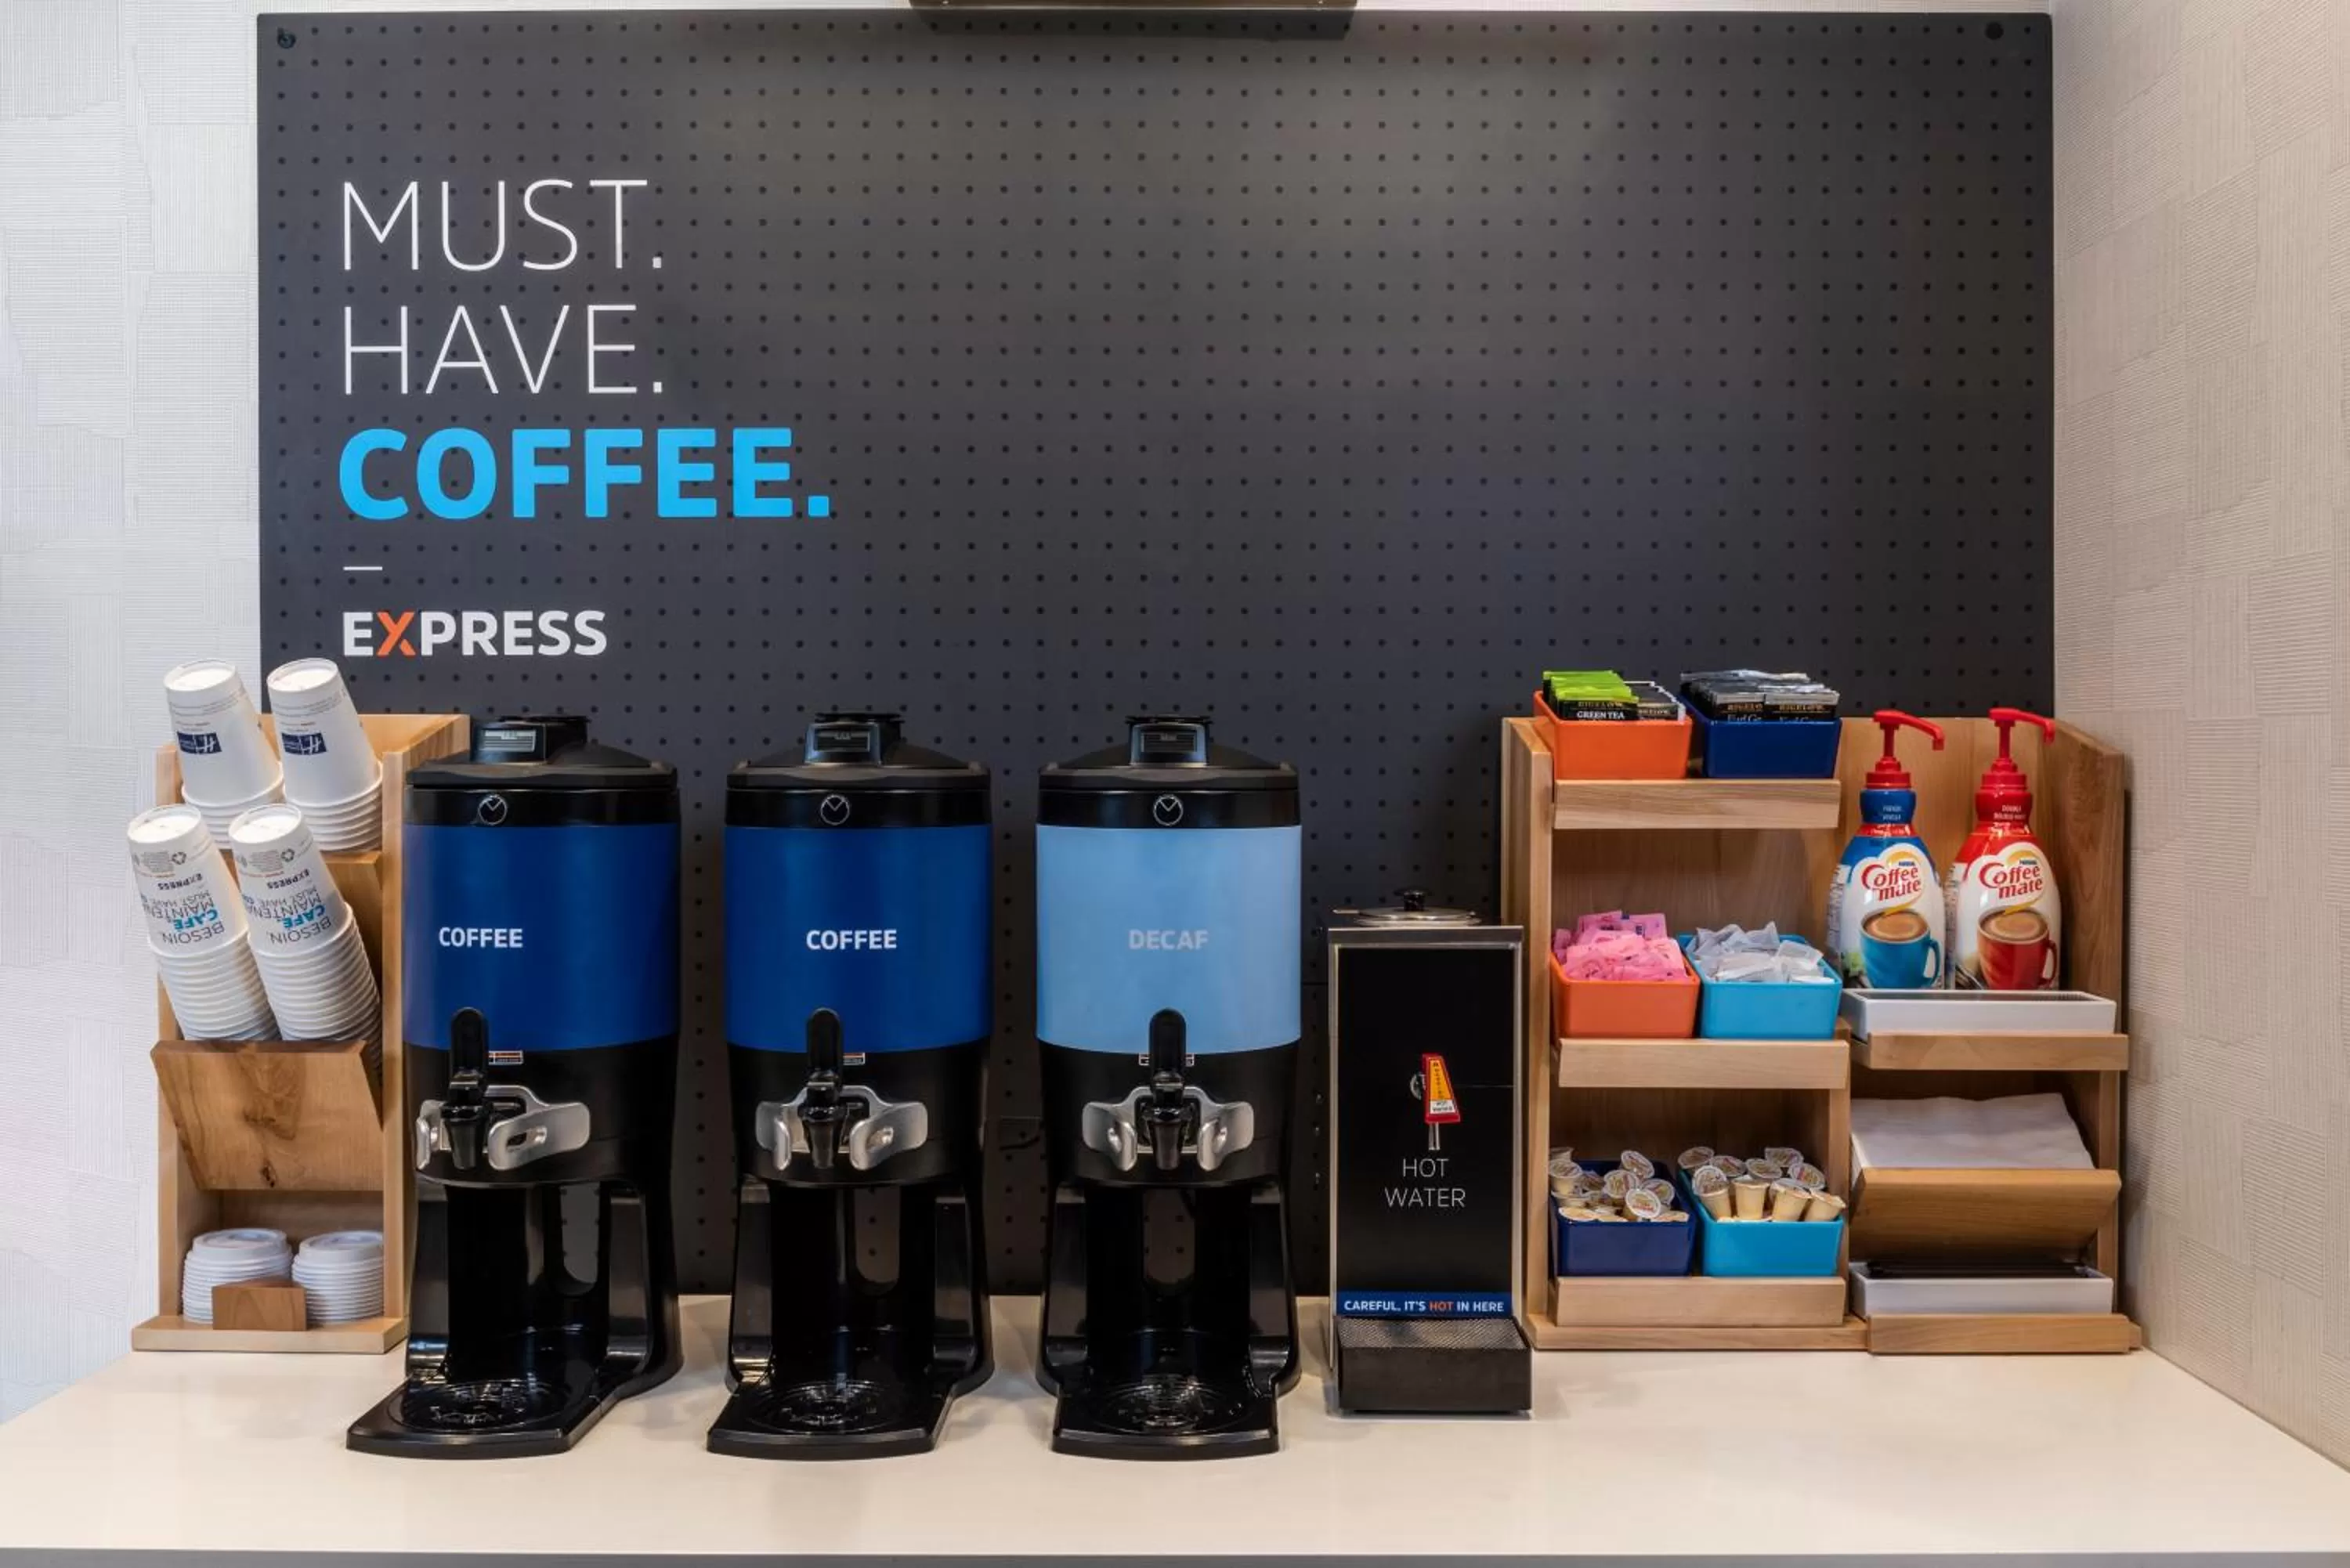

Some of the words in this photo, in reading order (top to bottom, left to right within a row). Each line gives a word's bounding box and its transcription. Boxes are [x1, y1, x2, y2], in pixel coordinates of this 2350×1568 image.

[343, 179, 663, 271] MUST.
[344, 304, 663, 395] HAVE.
[339, 428, 830, 520] COFFEE.
[343, 610, 607, 657] EXPRESS
[1577, 710, 1607, 719] GREEN
[1607, 711, 1625, 720] TEA
[267, 868, 310, 890] EXPRESS
[1861, 864, 1919, 889] Coffee
[1979, 862, 2041, 889] Coffee
[1998, 877, 2043, 899] mate
[439, 927, 524, 948] COFFEE
[806, 929, 898, 951] COFFEE
[1129, 929, 1209, 951] DECAF
[1402, 1158, 1450, 1178] HOT
[1384, 1187, 1466, 1208] WATER
[1405, 1300, 1426, 1311] IT'S
[1429, 1301, 1454, 1312] HOT
[1456, 1301, 1470, 1312] IN
[1473, 1301, 1505, 1312] HERE
